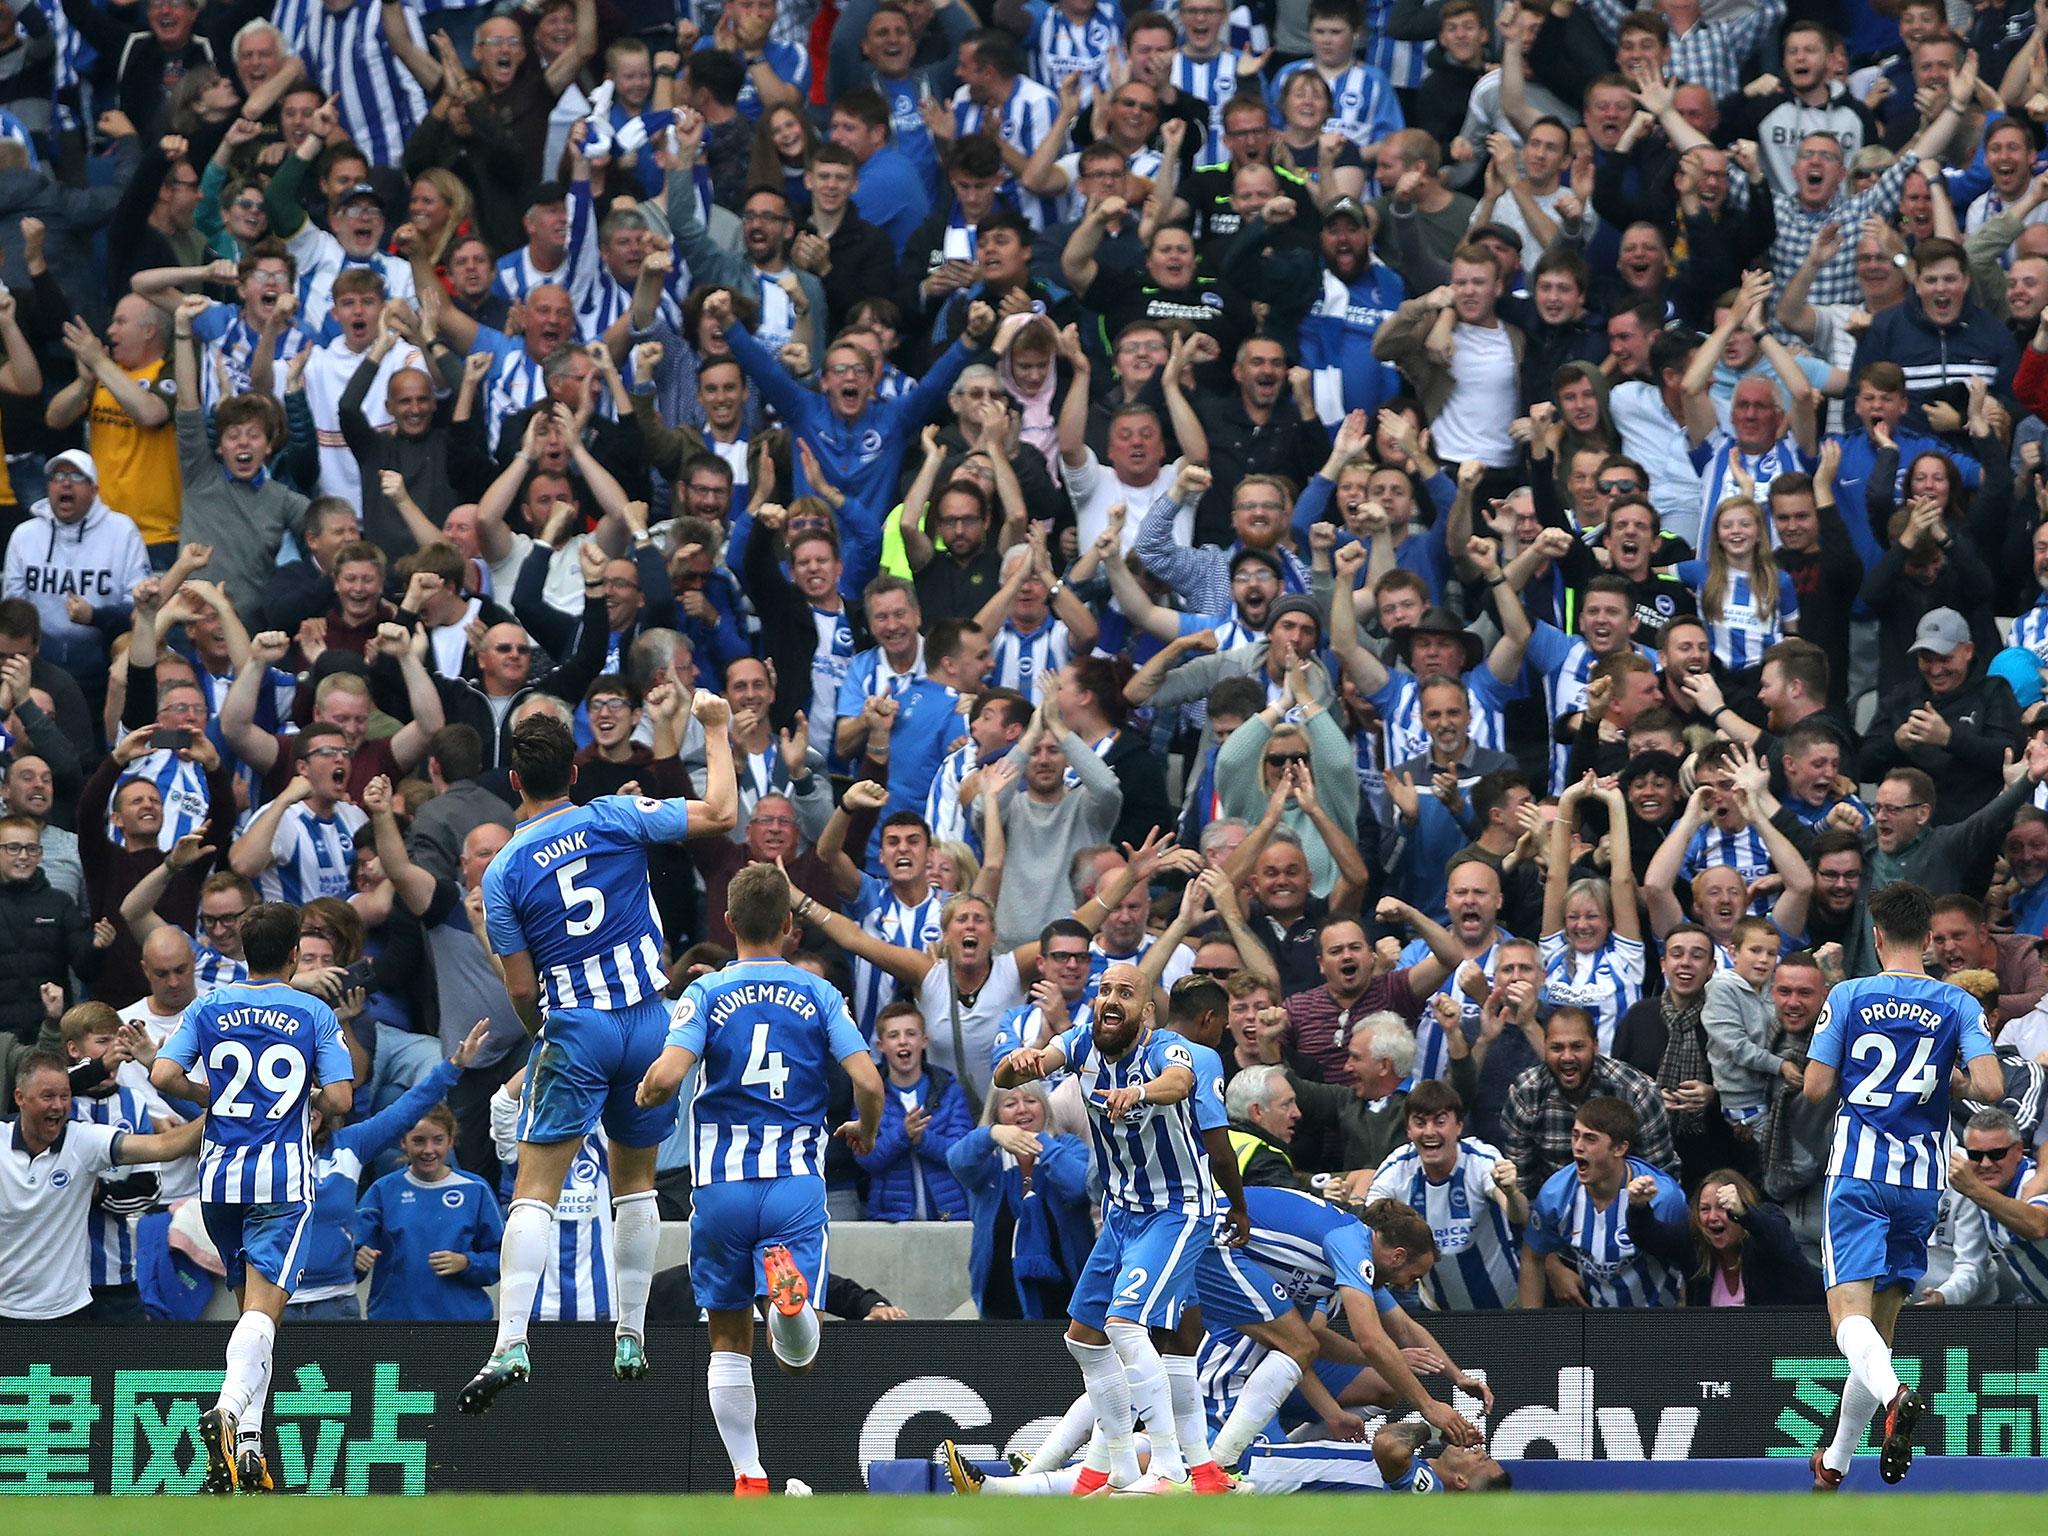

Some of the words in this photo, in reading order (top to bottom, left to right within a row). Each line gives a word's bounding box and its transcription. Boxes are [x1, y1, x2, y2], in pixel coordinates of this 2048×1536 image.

[26, 567, 112, 597] BHAFC
[532, 831, 588, 868] DUNK
[556, 856, 606, 936] 5
[217, 1007, 300, 1036] SUTTNER
[710, 983, 817, 1027] HÜNEMEIER
[1860, 997, 1942, 1031] PRÖPPER
[741, 1023, 790, 1099] 4
[1171, 1049, 1191, 1062] JD
[1847, 1033, 1939, 1107] 24
[209, 1040, 307, 1119] 29
[1119, 1267, 1149, 1300] 2
